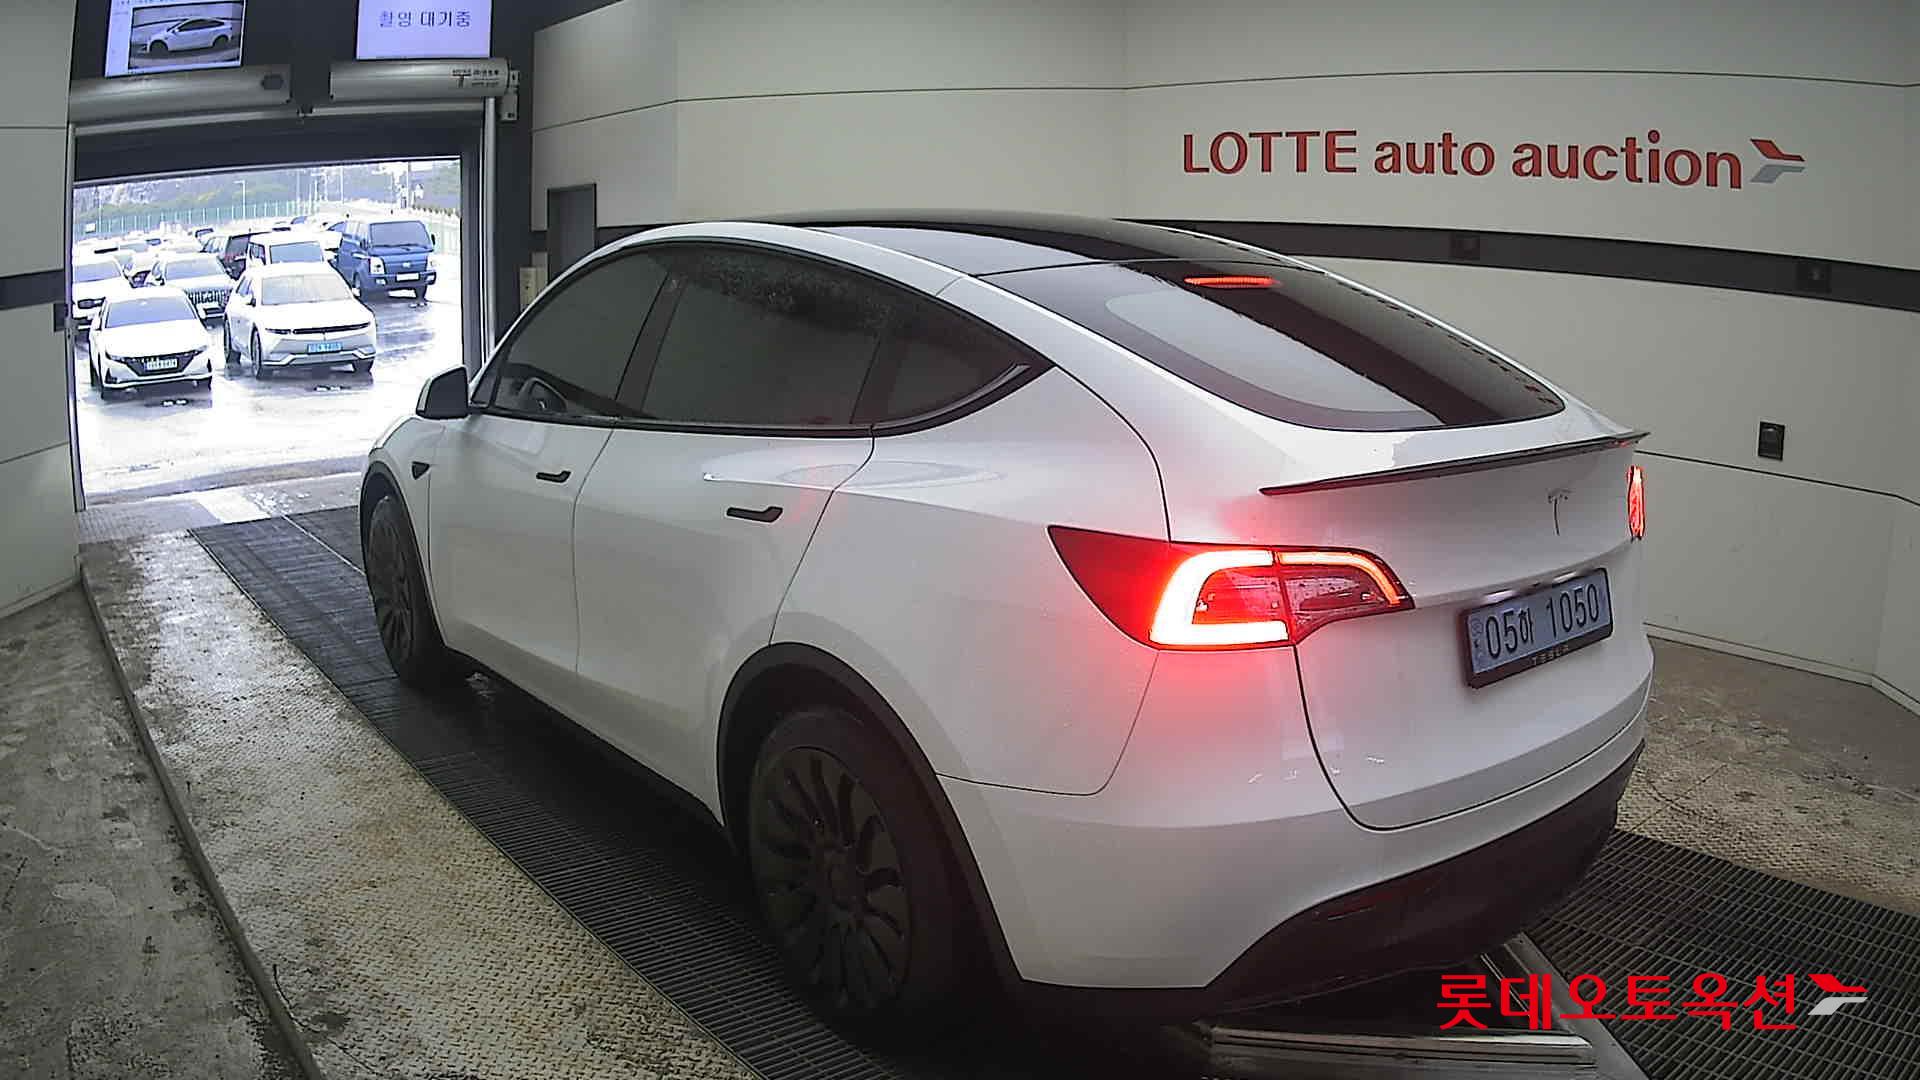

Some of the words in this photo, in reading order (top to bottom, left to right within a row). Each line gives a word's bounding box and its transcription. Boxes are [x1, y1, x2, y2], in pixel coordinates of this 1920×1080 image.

[420, 10, 471, 28] 대기중
[1183, 130, 1357, 174] LOTTE
[1374, 132, 1495, 177] auto
[1512, 129, 1743, 189] auction
[1485, 607, 1535, 659] 05하
[1546, 583, 1599, 638] 1050
